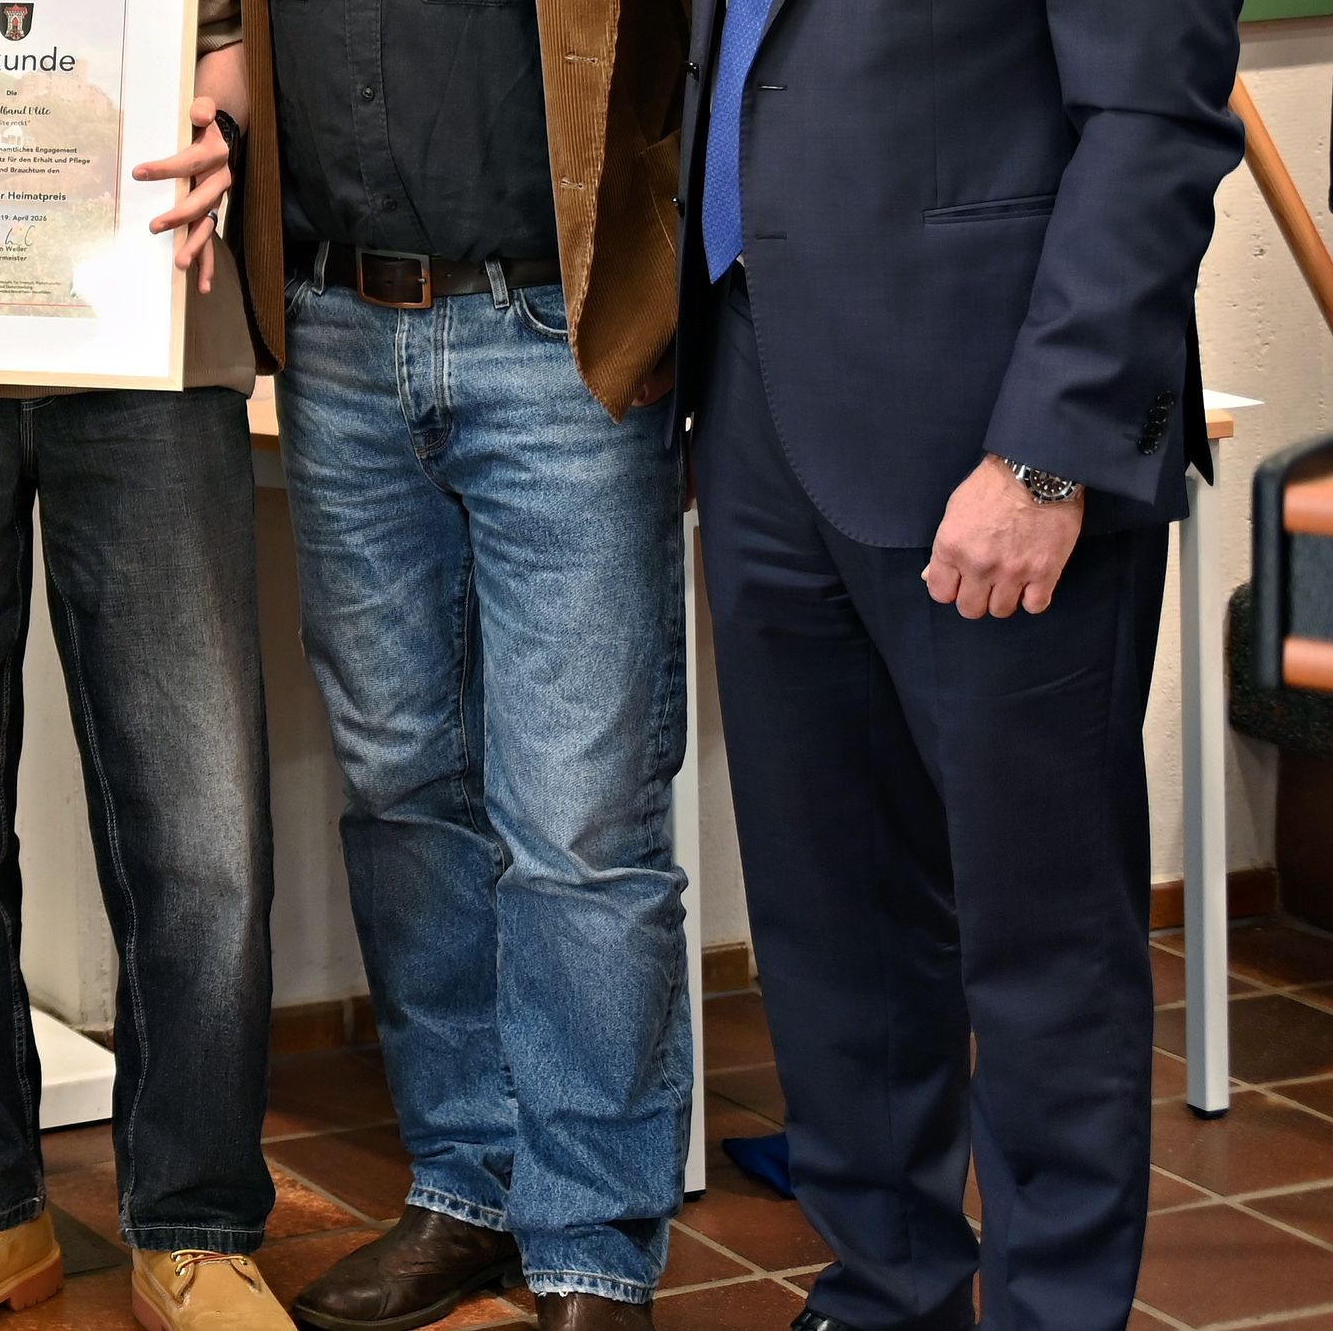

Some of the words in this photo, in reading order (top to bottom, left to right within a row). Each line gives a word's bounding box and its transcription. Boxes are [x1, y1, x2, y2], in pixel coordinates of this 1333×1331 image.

[35, 146, 78, 155] Engagement
[69, 157, 91, 165] Pflege
[8, 191, 67, 203] Heimatpreis
[12, 214, 29, 222] April
